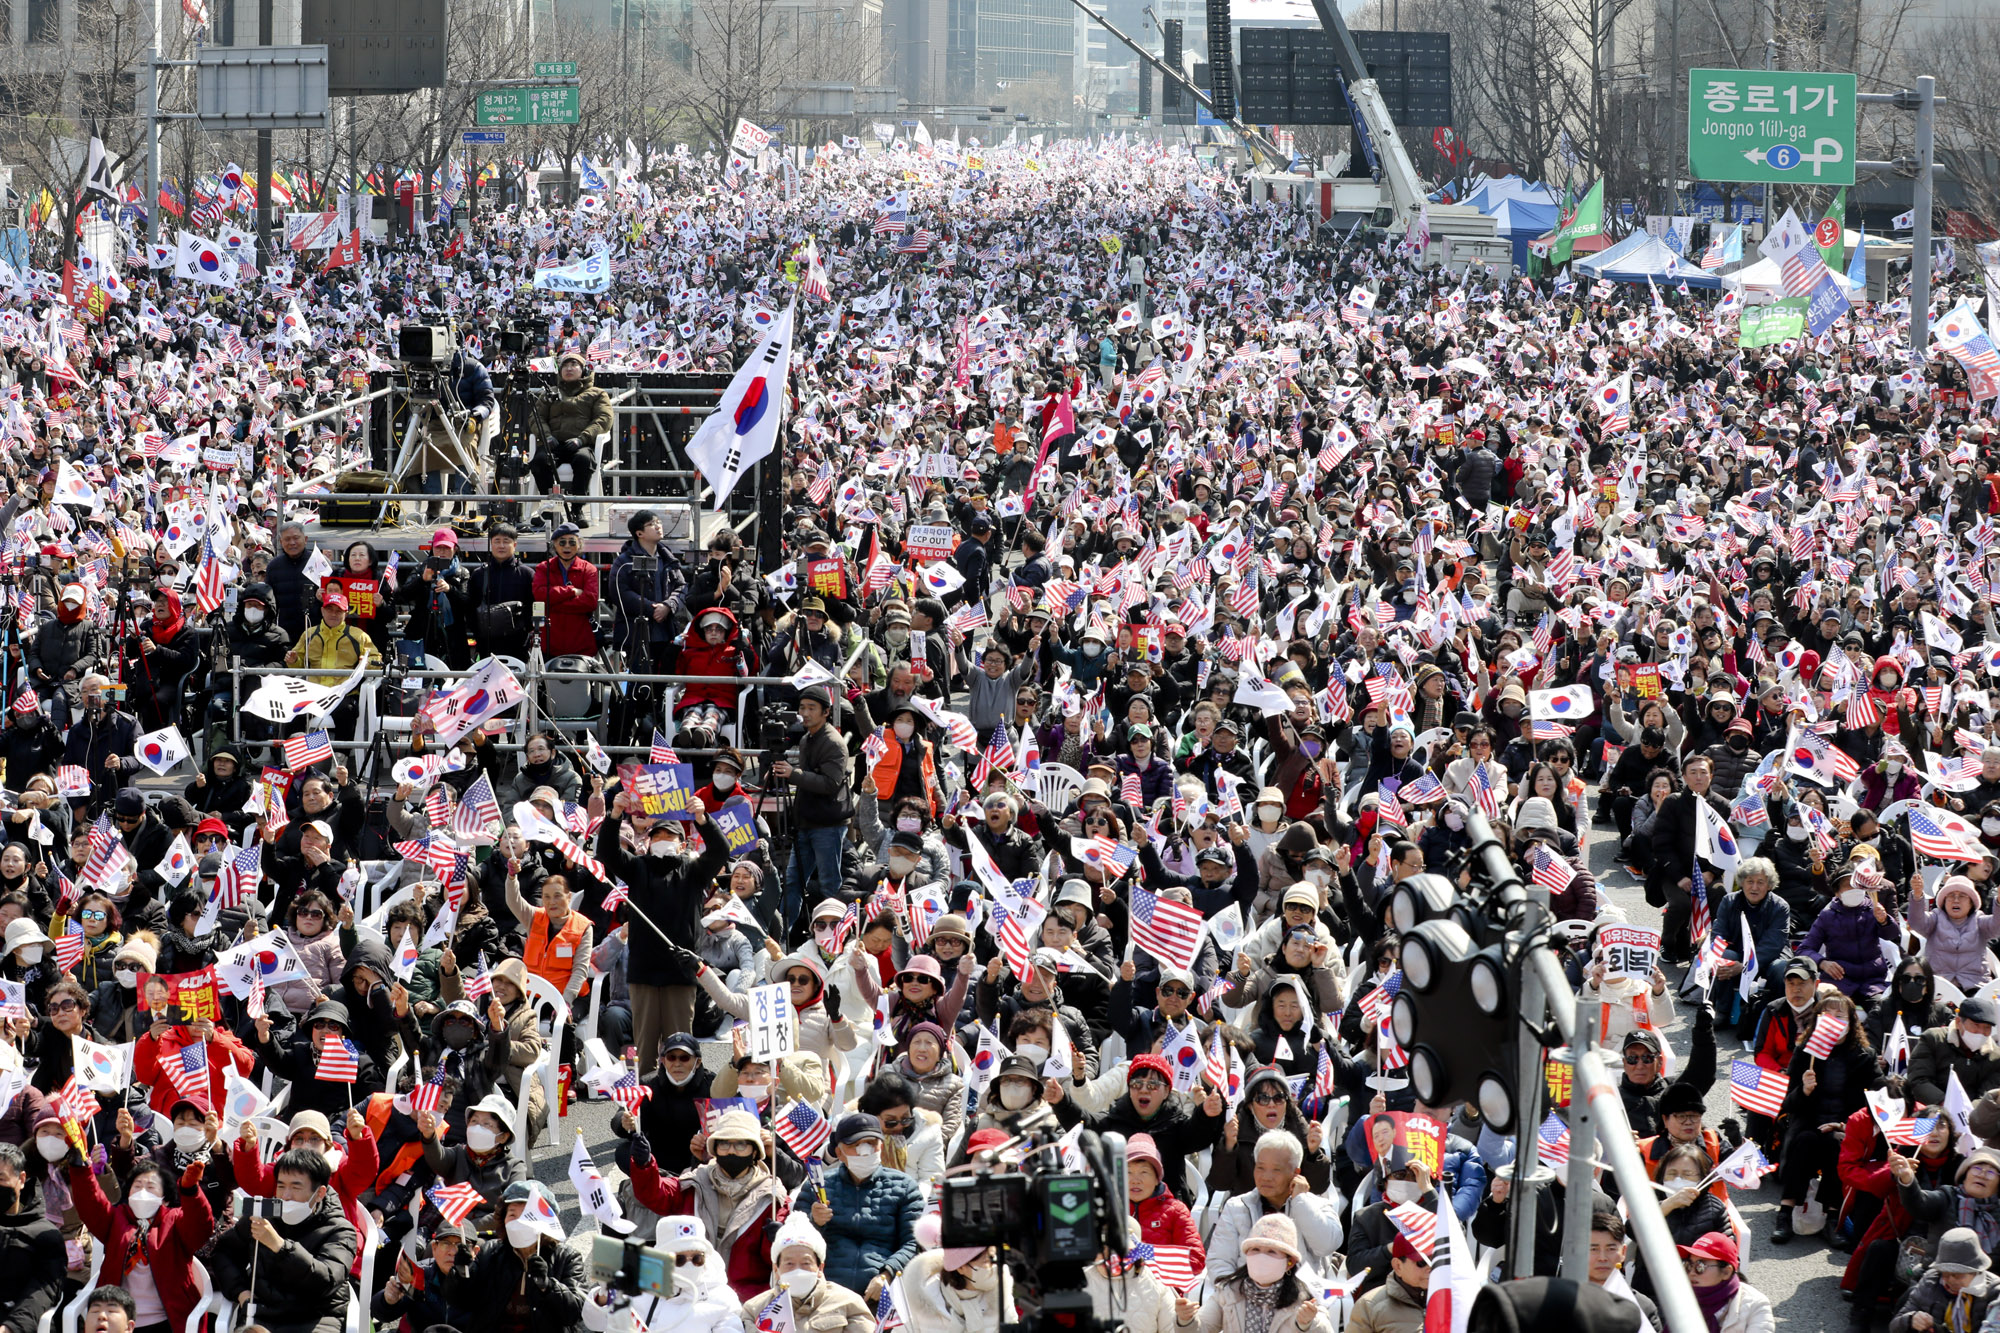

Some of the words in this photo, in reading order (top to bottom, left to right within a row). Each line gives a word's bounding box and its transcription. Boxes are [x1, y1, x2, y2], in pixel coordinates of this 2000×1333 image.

[539, 64, 572, 74] 청계광장
[483, 95, 518, 105] 청계1가
[541, 90, 569, 100] 숭례문
[1703, 81, 1839, 117] 종로1가
[541, 108, 559, 118] 시청
[741, 124, 769, 144] STOP
[1701, 118, 1754, 140] Jongno
[1759, 120, 1807, 142] 1(il)-ga
[1777, 148, 1790, 166] 6
[1822, 222, 1835, 244] 3사
[936, 528, 952, 536] OUT
[934, 550, 952, 558] OUT
[814, 572, 840, 584] 탄핵
[349, 592, 374, 604] 탄핵
[816, 582, 841, 598] 기각
[349, 603, 374, 616] 기각
[1636, 675, 1658, 688] 탄핵
[1637, 686, 1660, 698] 기각
[635, 768, 679, 794] 국회
[641, 788, 691, 816] 해체!
[717, 811, 740, 834] 회
[727, 823, 756, 852] 체!
[1603, 930, 1659, 948] 자유민주주의
[1608, 946, 1654, 976] 회복!
[178, 986, 214, 1007] 탄핵
[755, 986, 786, 1023] 정읍
[180, 1003, 216, 1022] 기각
[758, 1022, 788, 1056] 고창
